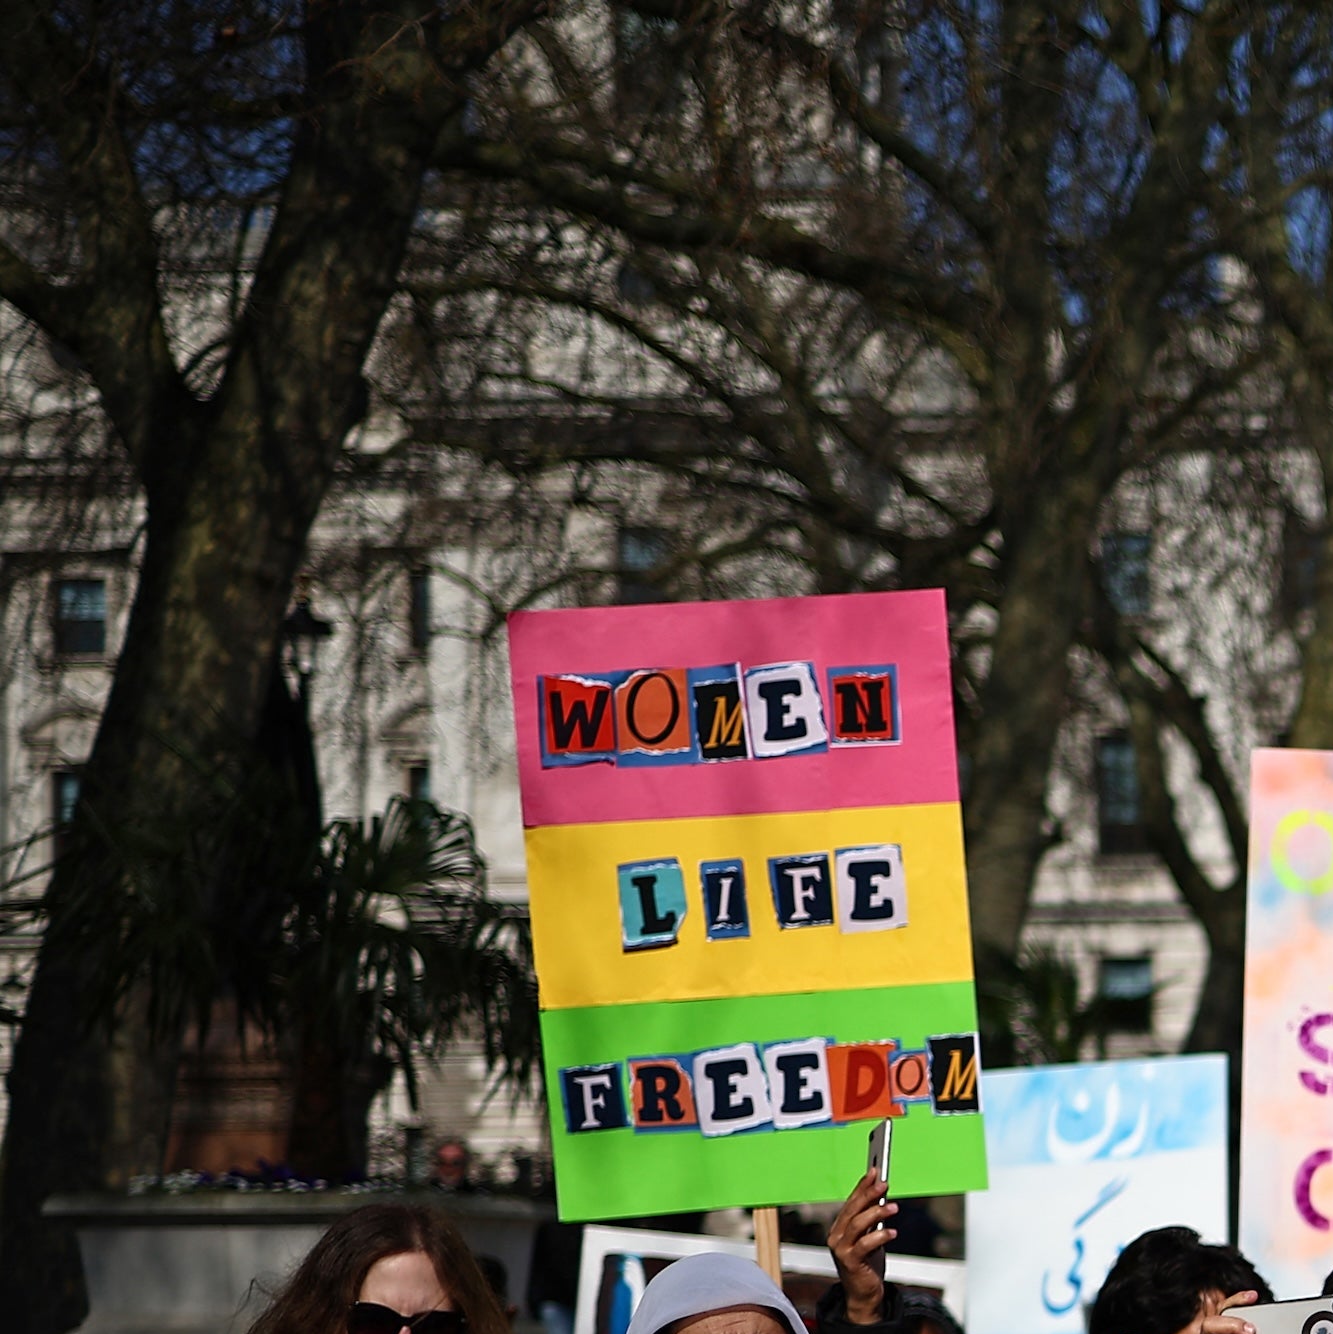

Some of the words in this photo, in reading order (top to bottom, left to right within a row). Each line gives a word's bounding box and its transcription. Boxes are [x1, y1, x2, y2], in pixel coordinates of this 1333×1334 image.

[550, 669, 889, 749] WOMEN
[631, 861, 894, 937] LIFE
[575, 1042, 977, 1129] FREEDOM
